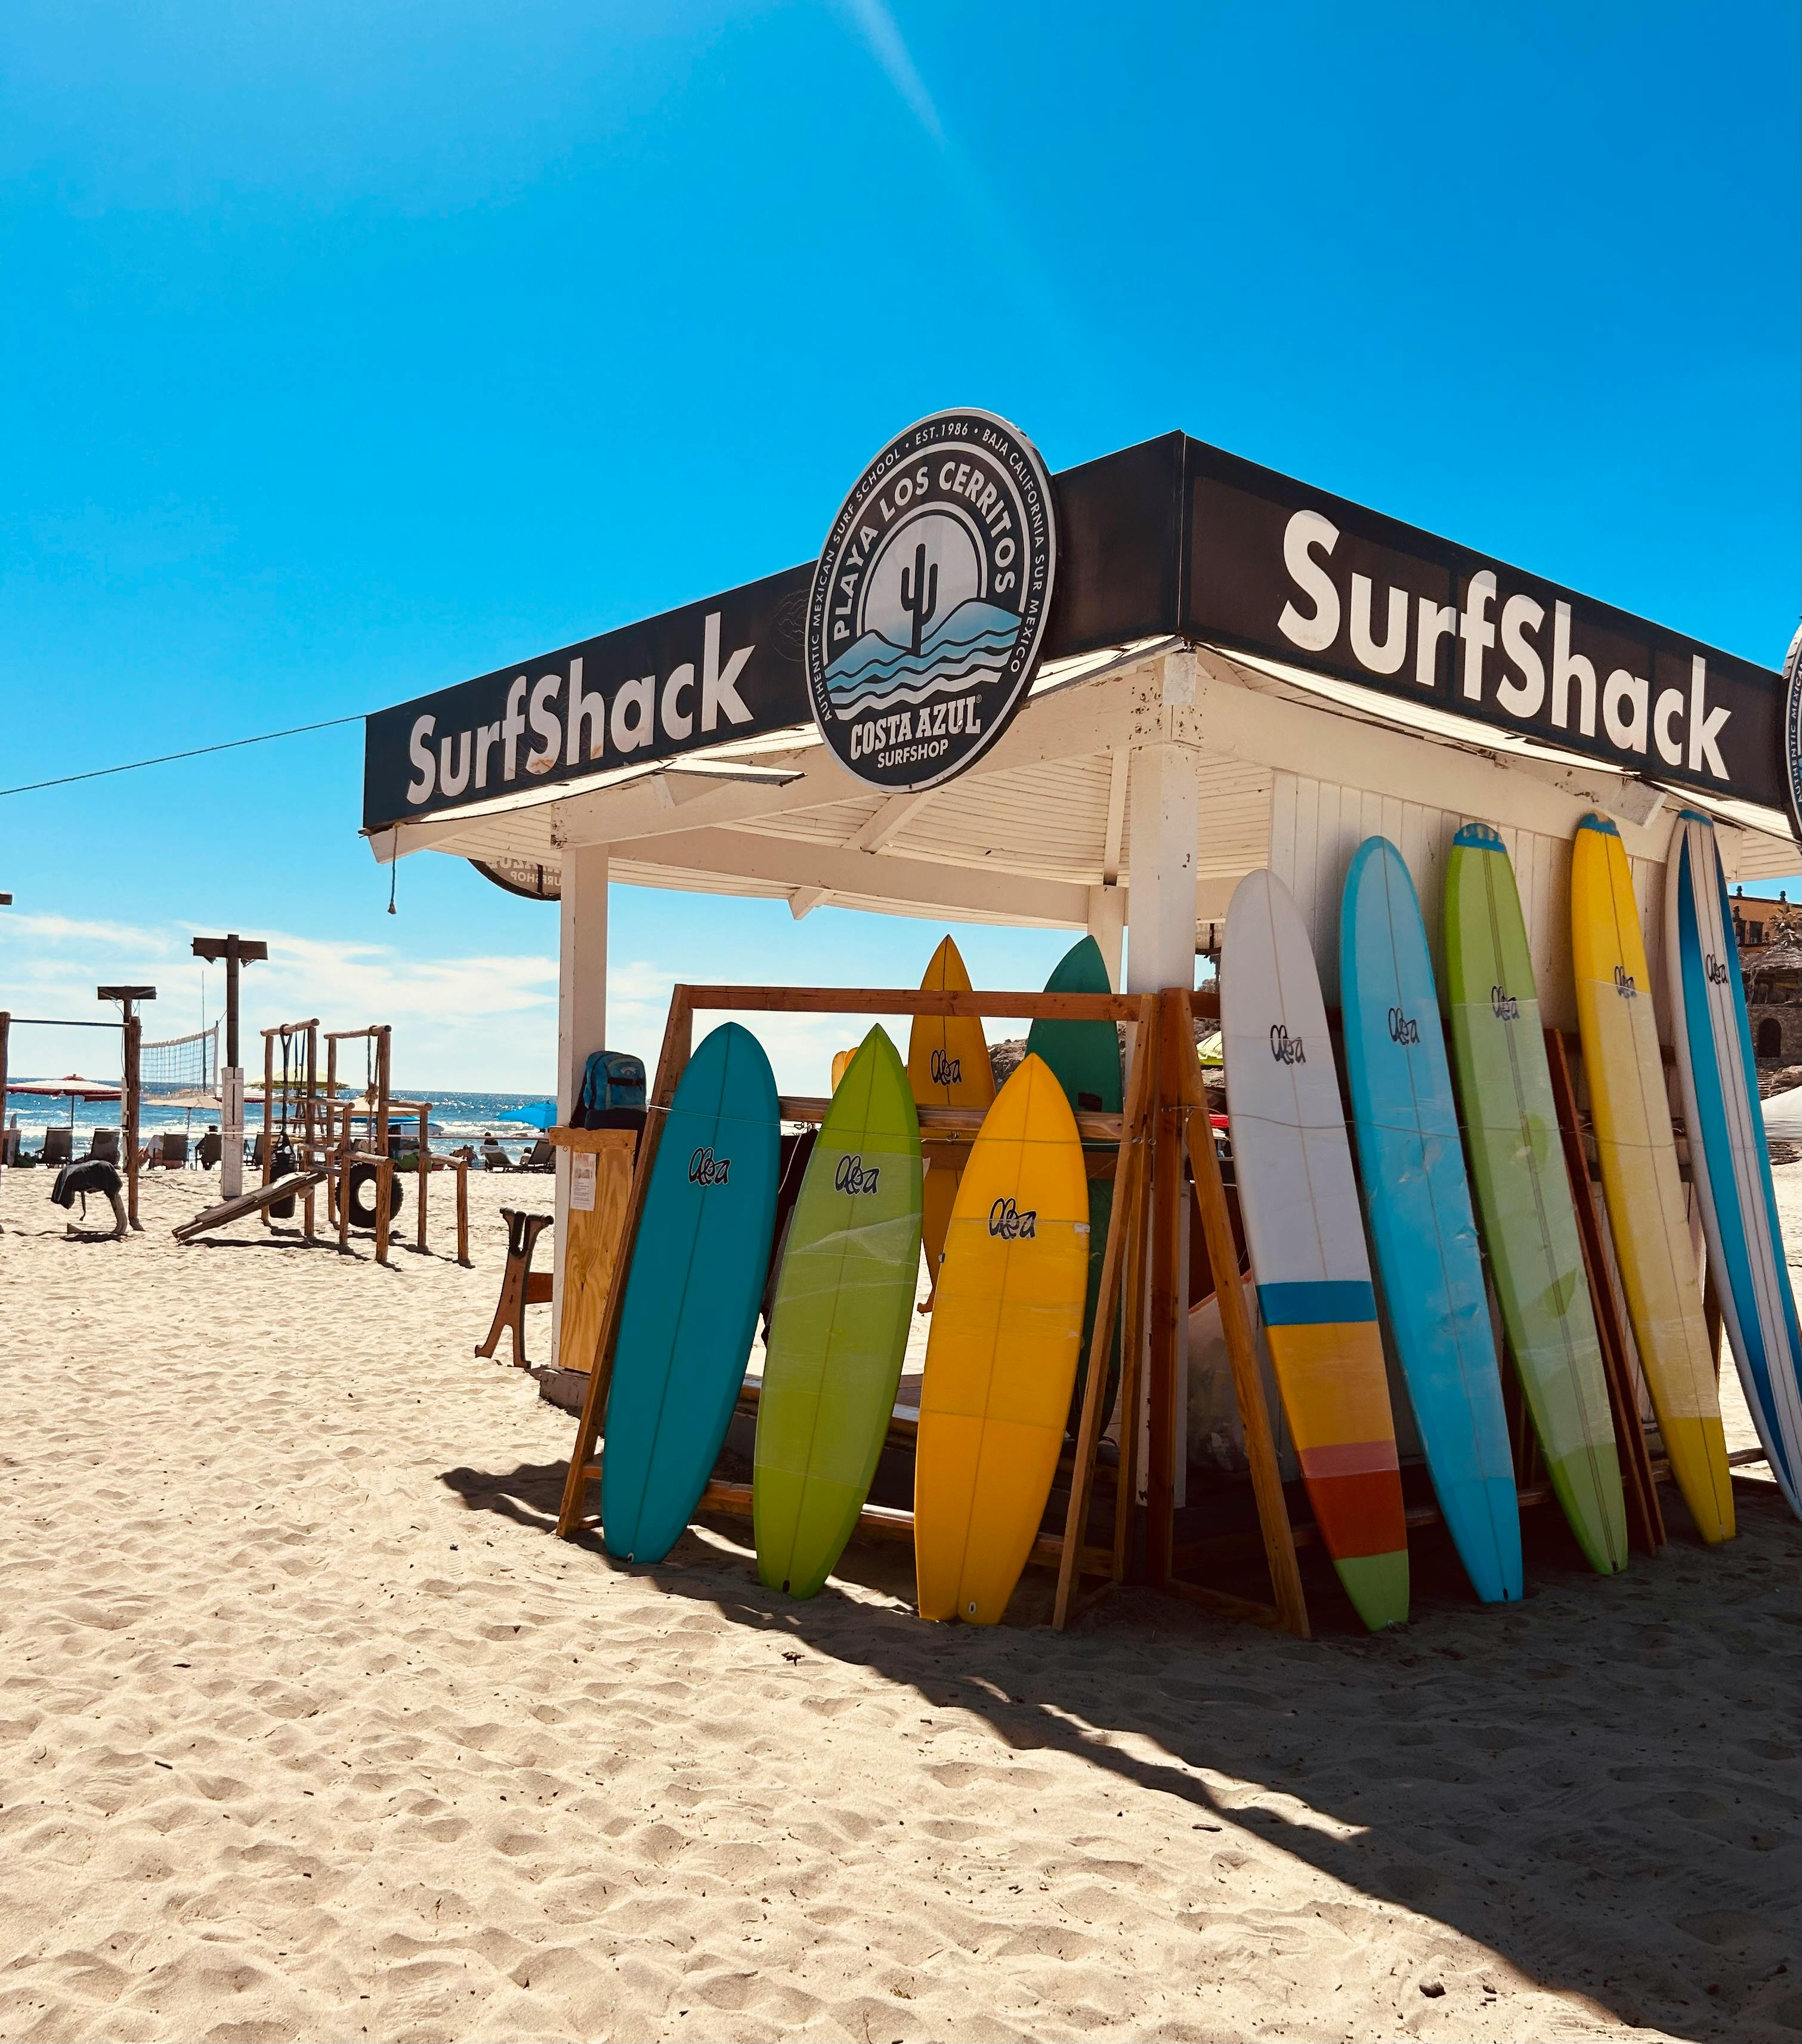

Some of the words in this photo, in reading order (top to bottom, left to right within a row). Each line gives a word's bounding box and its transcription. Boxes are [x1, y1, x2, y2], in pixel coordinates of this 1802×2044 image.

[856, 449, 900, 502] SCHOOL
[982, 428, 1009, 456] BAJA
[833, 503, 854, 544] SURF
[1009, 453, 1044, 548] CALIFORNIA
[813, 549, 834, 626] MEXICAN
[834, 525, 879, 641] PLAYA
[879, 466, 929, 522] LOS
[939, 461, 1015, 593] CERRITOS
[1033, 554, 1044, 590] SUR
[1011, 599, 1040, 673] MEXICO
[1277, 509, 1731, 780] SurfShack
[406, 611, 756, 805] SurfShack
[812, 634, 832, 721] AUTHENTIC
[850, 712, 912, 760] COSTA
[877, 738, 948, 768] SURFSHOP
